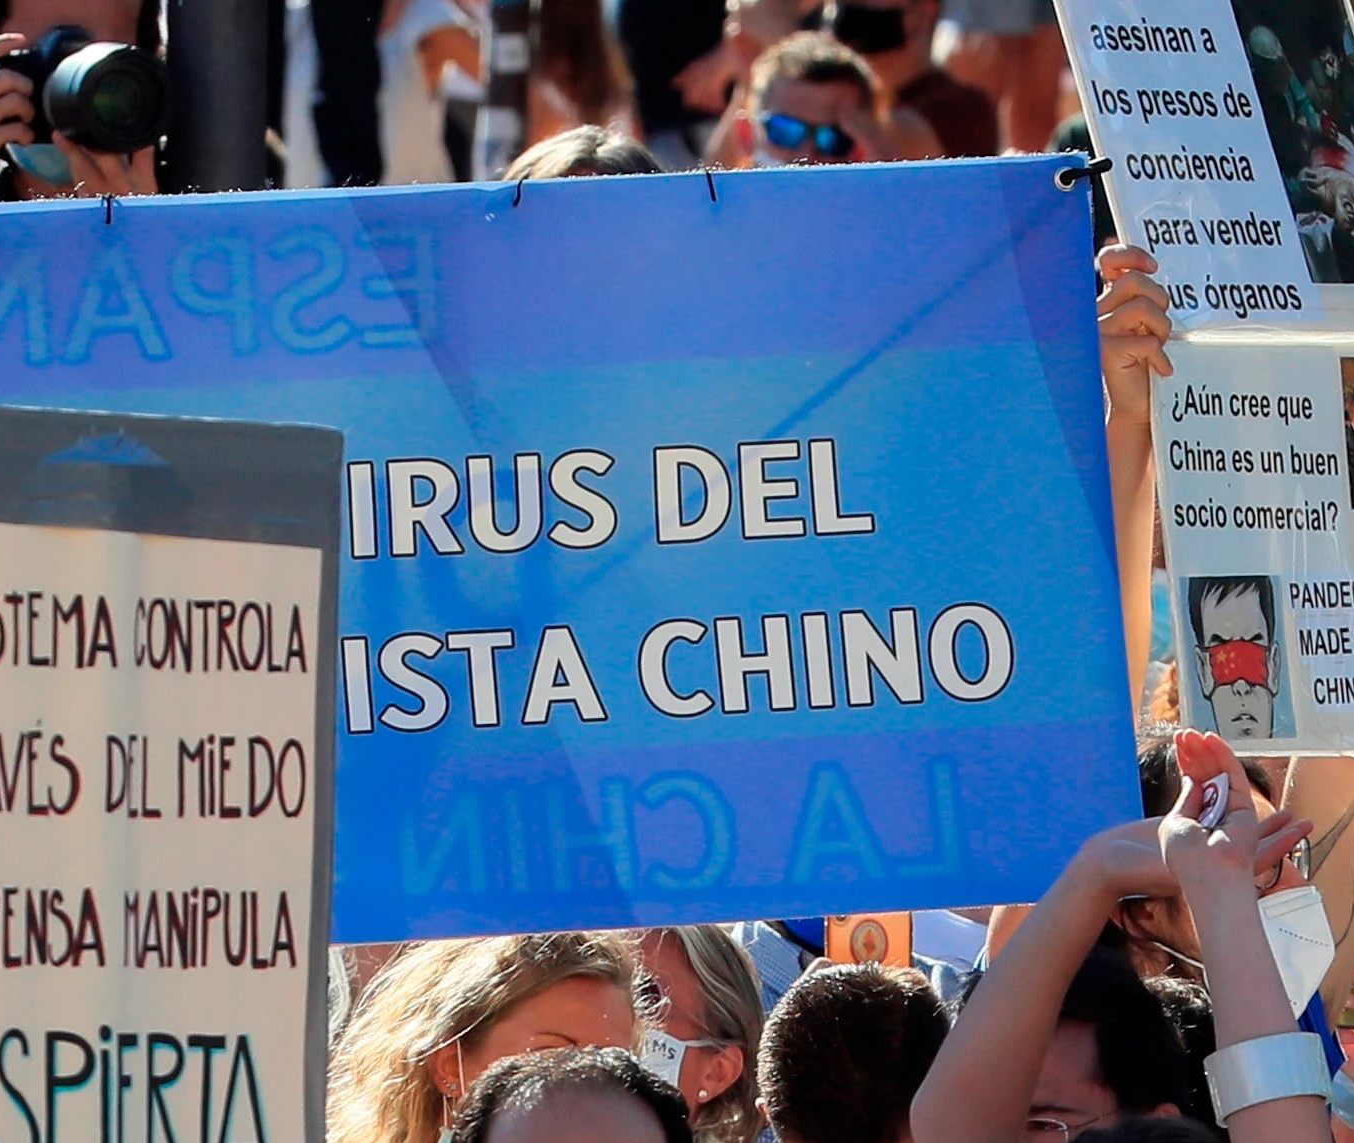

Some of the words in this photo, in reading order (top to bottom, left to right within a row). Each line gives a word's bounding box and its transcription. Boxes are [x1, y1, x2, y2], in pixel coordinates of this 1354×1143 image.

[1091, 18, 1196, 53] asesinan
[1200, 27, 1217, 54] a
[1091, 80, 1133, 116] los
[1137, 89, 1218, 124] presos
[1224, 84, 1253, 119] de
[1127, 146, 1255, 182] conciencia
[1143, 219, 1198, 253] para
[1201, 212, 1282, 247] vender
[1170, 285, 1199, 310] us
[1205, 274, 1303, 319] órganos
[1172, 384, 1223, 422] ¿Aún
[1229, 392, 1271, 417] cree
[1278, 394, 1313, 426] que
[1169, 440, 1226, 472] China
[1232, 450, 1254, 473] es
[1260, 450, 1285, 474] un
[1291, 444, 1339, 476] buen
[347, 446, 619, 559] IRUS
[652, 437, 876, 546] DEL
[1174, 498, 1227, 528] socio
[1233, 500, 1338, 532] comercial?
[133, 597, 308, 674] CONTROLA
[1299, 627, 1352, 656] MADE
[341, 624, 608, 735] ISTA
[638, 601, 1014, 717] CHINO
[104, 733, 162, 819] DEL
